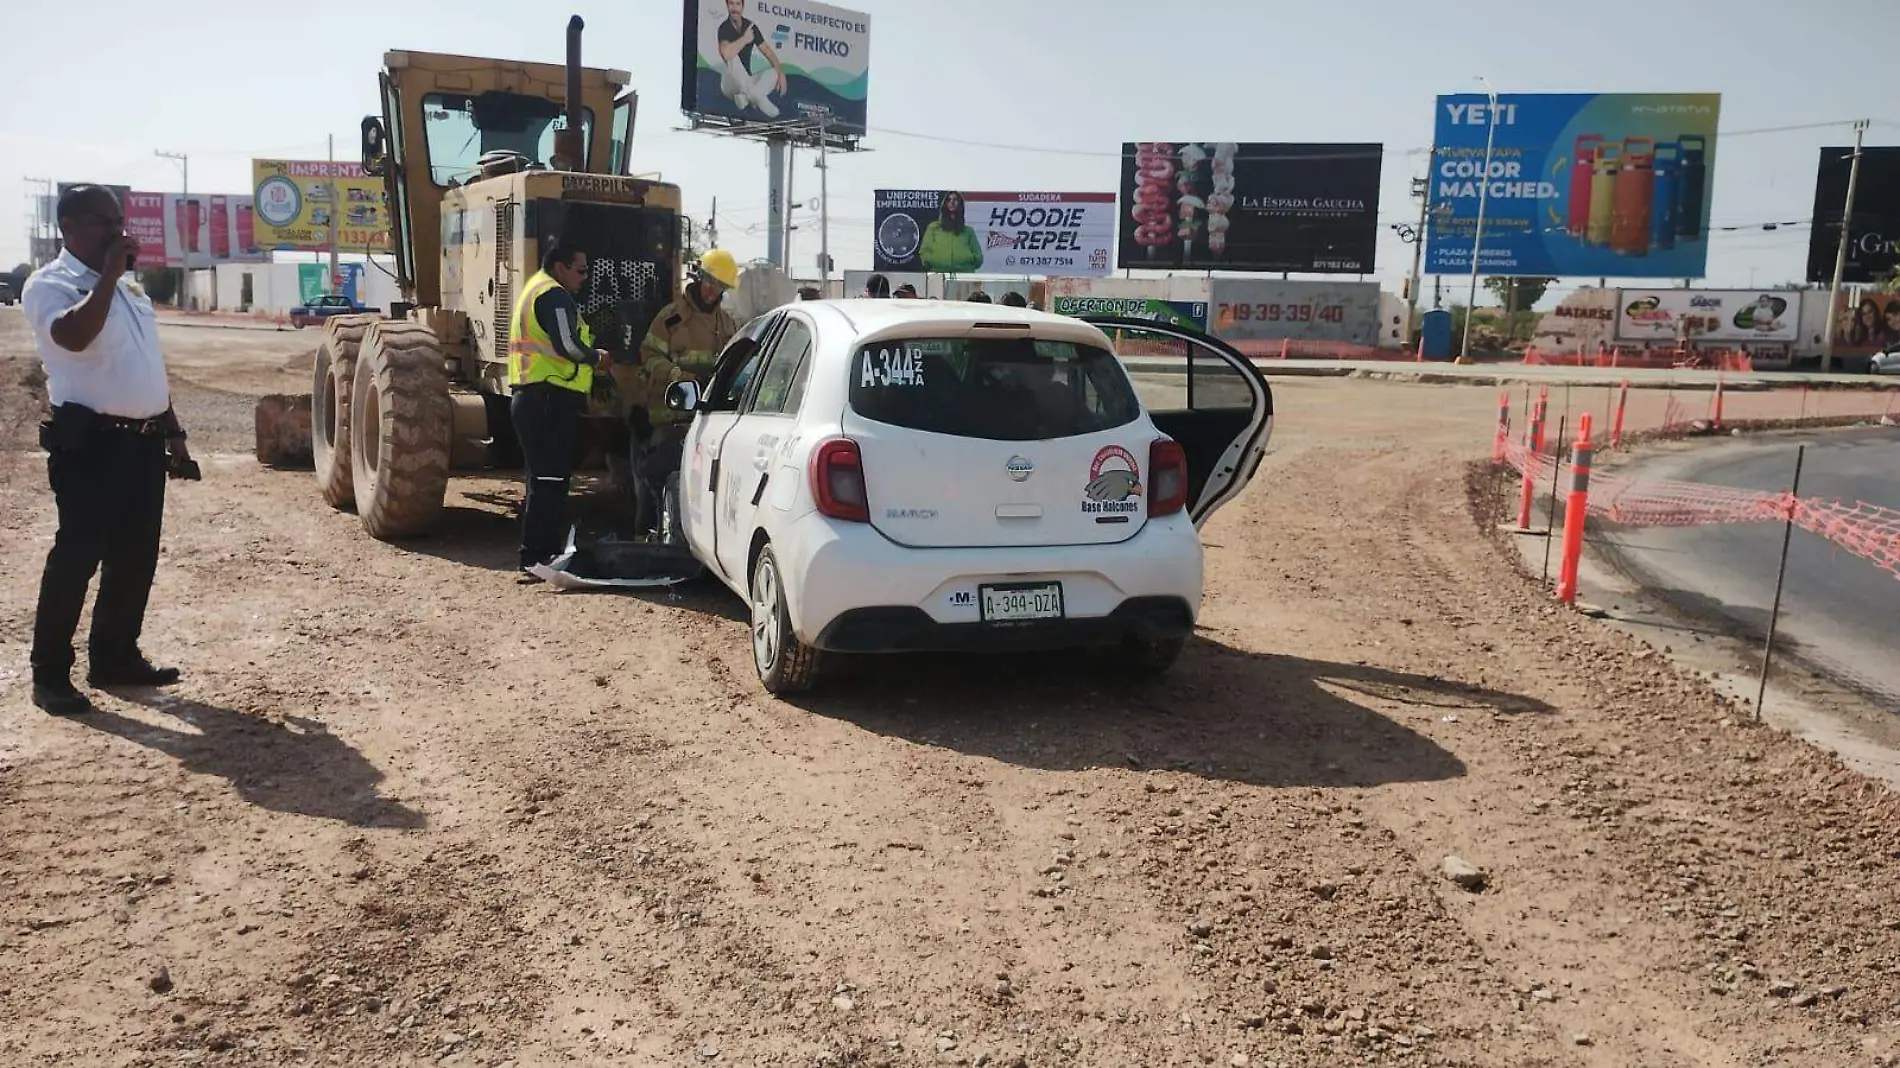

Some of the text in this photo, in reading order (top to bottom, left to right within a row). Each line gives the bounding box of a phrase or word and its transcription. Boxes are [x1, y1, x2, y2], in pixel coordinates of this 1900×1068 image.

[758, 2, 866, 33] EL CLIMA PERFECTO ES
[795, 32, 849, 57] FRIKKO
[1446, 104, 1517, 125] YETI
[1441, 161, 1520, 178] COLOR
[887, 191, 939, 200] UNIFORMES
[1018, 193, 1062, 201] SUDADERA
[1440, 182, 1560, 198] MATCHED.
[130, 196, 161, 208] YETI
[876, 200, 939, 209] EMPRESARIALES
[989, 207, 1085, 228] HOODIE
[1012, 231, 1082, 251] REPEL
[861, 348, 915, 388] A-344
[1082, 501, 1101, 513] Base
[986, 593, 1060, 614] A-344-DZA
